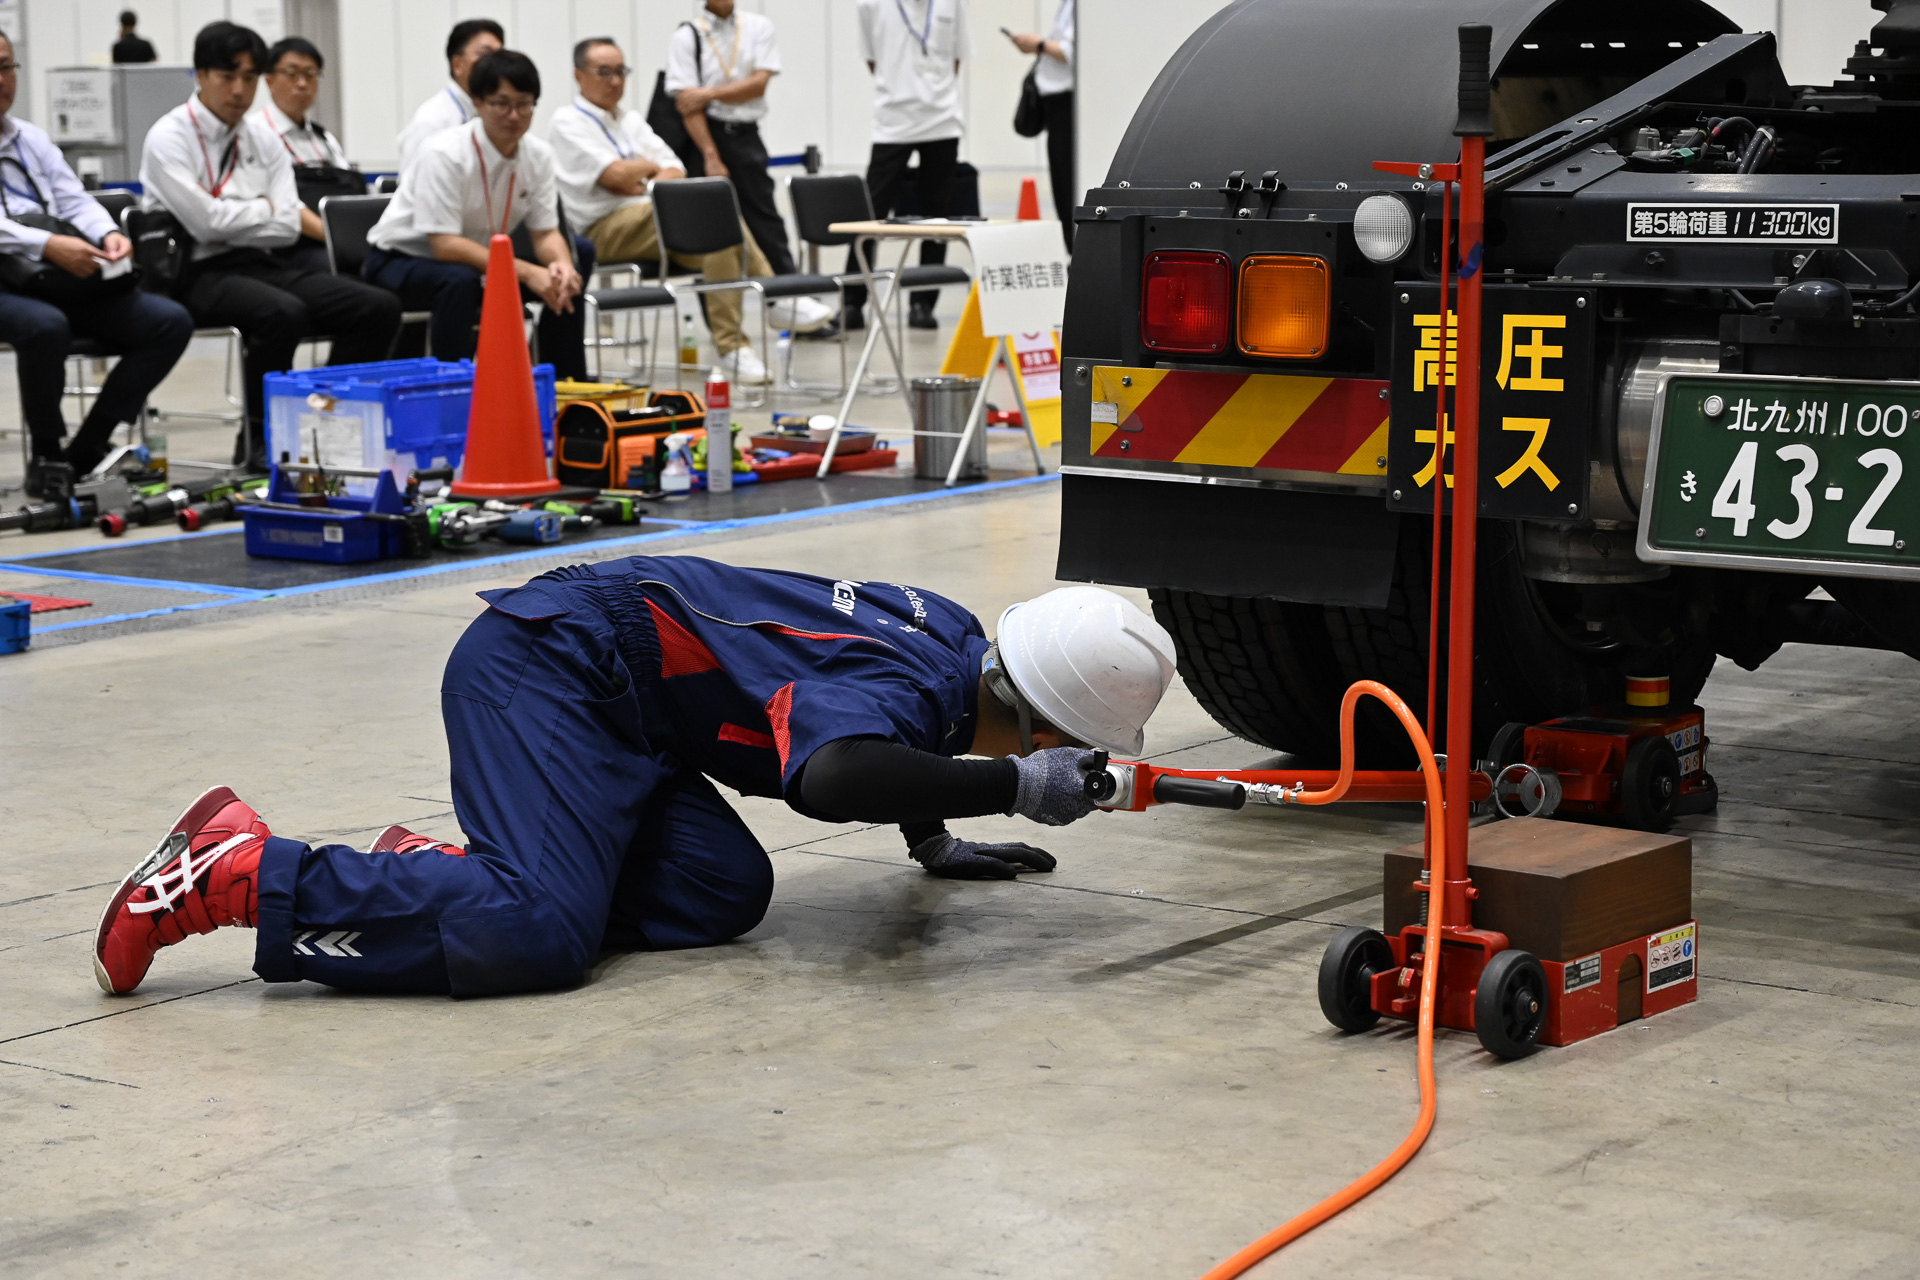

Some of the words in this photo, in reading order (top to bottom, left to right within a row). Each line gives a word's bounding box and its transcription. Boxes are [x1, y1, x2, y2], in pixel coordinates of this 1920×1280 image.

[981, 262, 1064, 292] 作業報告書
[1680, 470, 1697, 502] き
